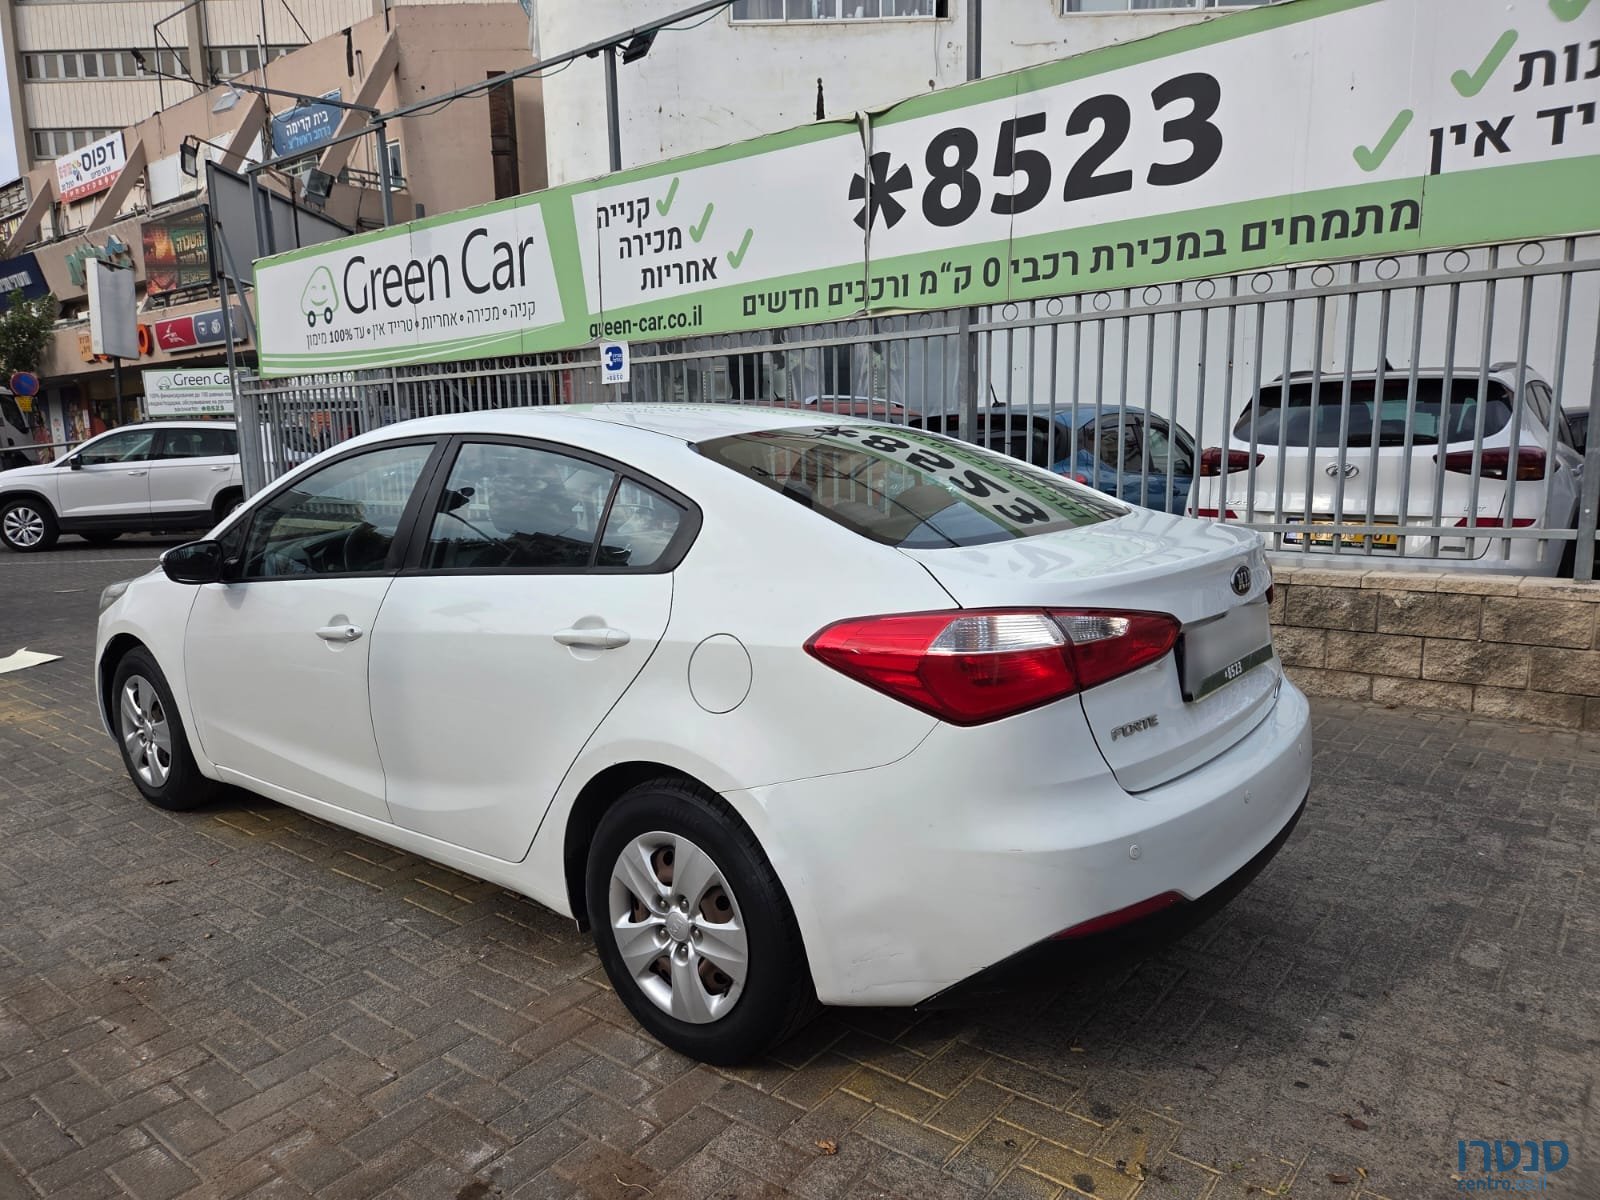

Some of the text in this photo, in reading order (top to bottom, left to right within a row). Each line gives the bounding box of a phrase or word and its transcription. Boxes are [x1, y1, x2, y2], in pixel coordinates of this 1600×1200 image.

[313, 110, 329, 126] בית
[81, 141, 115, 171] דפוס
[1429, 114, 1515, 176] אין
[597, 197, 650, 229] קנייה
[1241, 199, 1421, 252] מתמחים
[619, 227, 682, 259] מכירה
[1089, 228, 1226, 273] במכירת
[343, 228, 534, 314] Green Car
[640, 256, 718, 290] אחריות
[982, 257, 1000, 288] 0
[1010, 251, 1079, 283] רכבי
[743, 286, 819, 317] חדשים
[828, 274, 909, 306] ורכבים
[306, 301, 536, 350] קניה מכירה אחריות טרייד אין עד 100% מימון
[173, 372, 230, 386] Green Ca
[1111, 714, 1159, 741] FORTE
